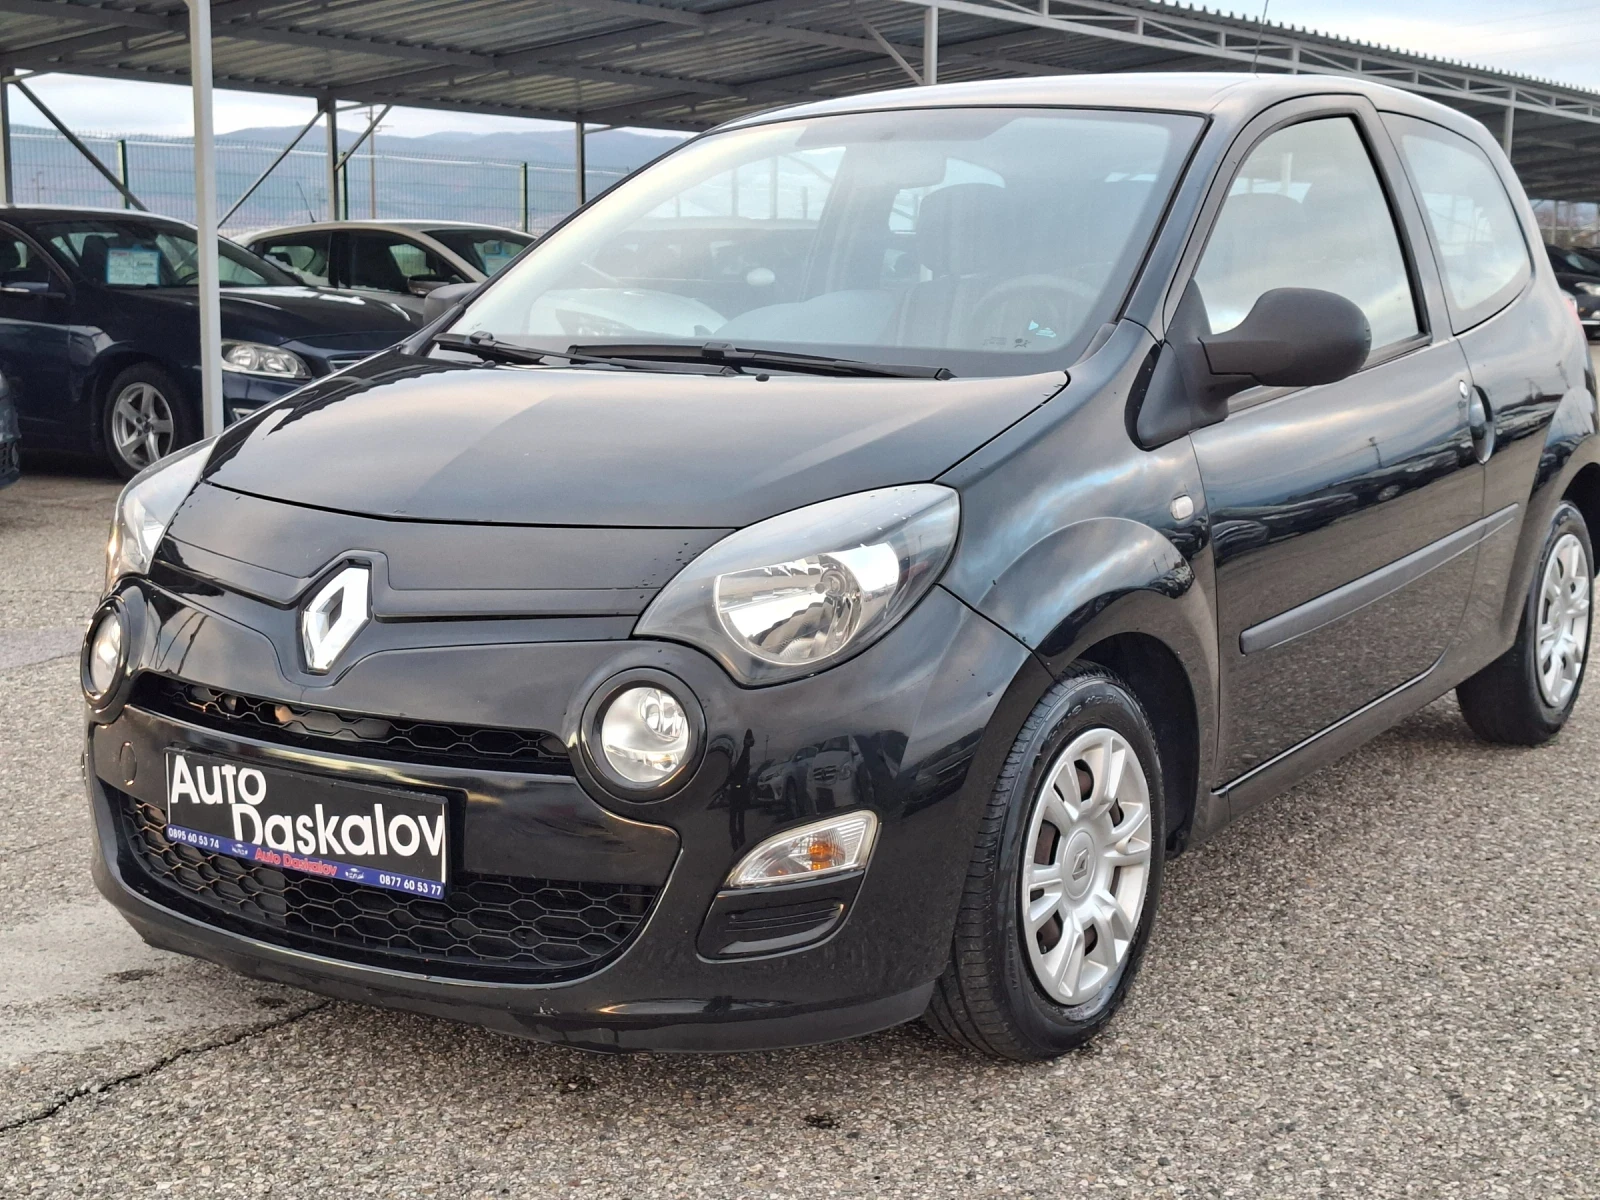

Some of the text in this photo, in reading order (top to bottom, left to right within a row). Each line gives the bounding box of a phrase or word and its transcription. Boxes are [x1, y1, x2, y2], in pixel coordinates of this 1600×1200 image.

[170, 754, 267, 805] Auto
[168, 827, 220, 849] 0895 60 53 74
[231, 803, 444, 857] Daskalov
[255, 847, 338, 877] Auto Daskalov
[379, 873, 442, 896] 0877 60 53 77
